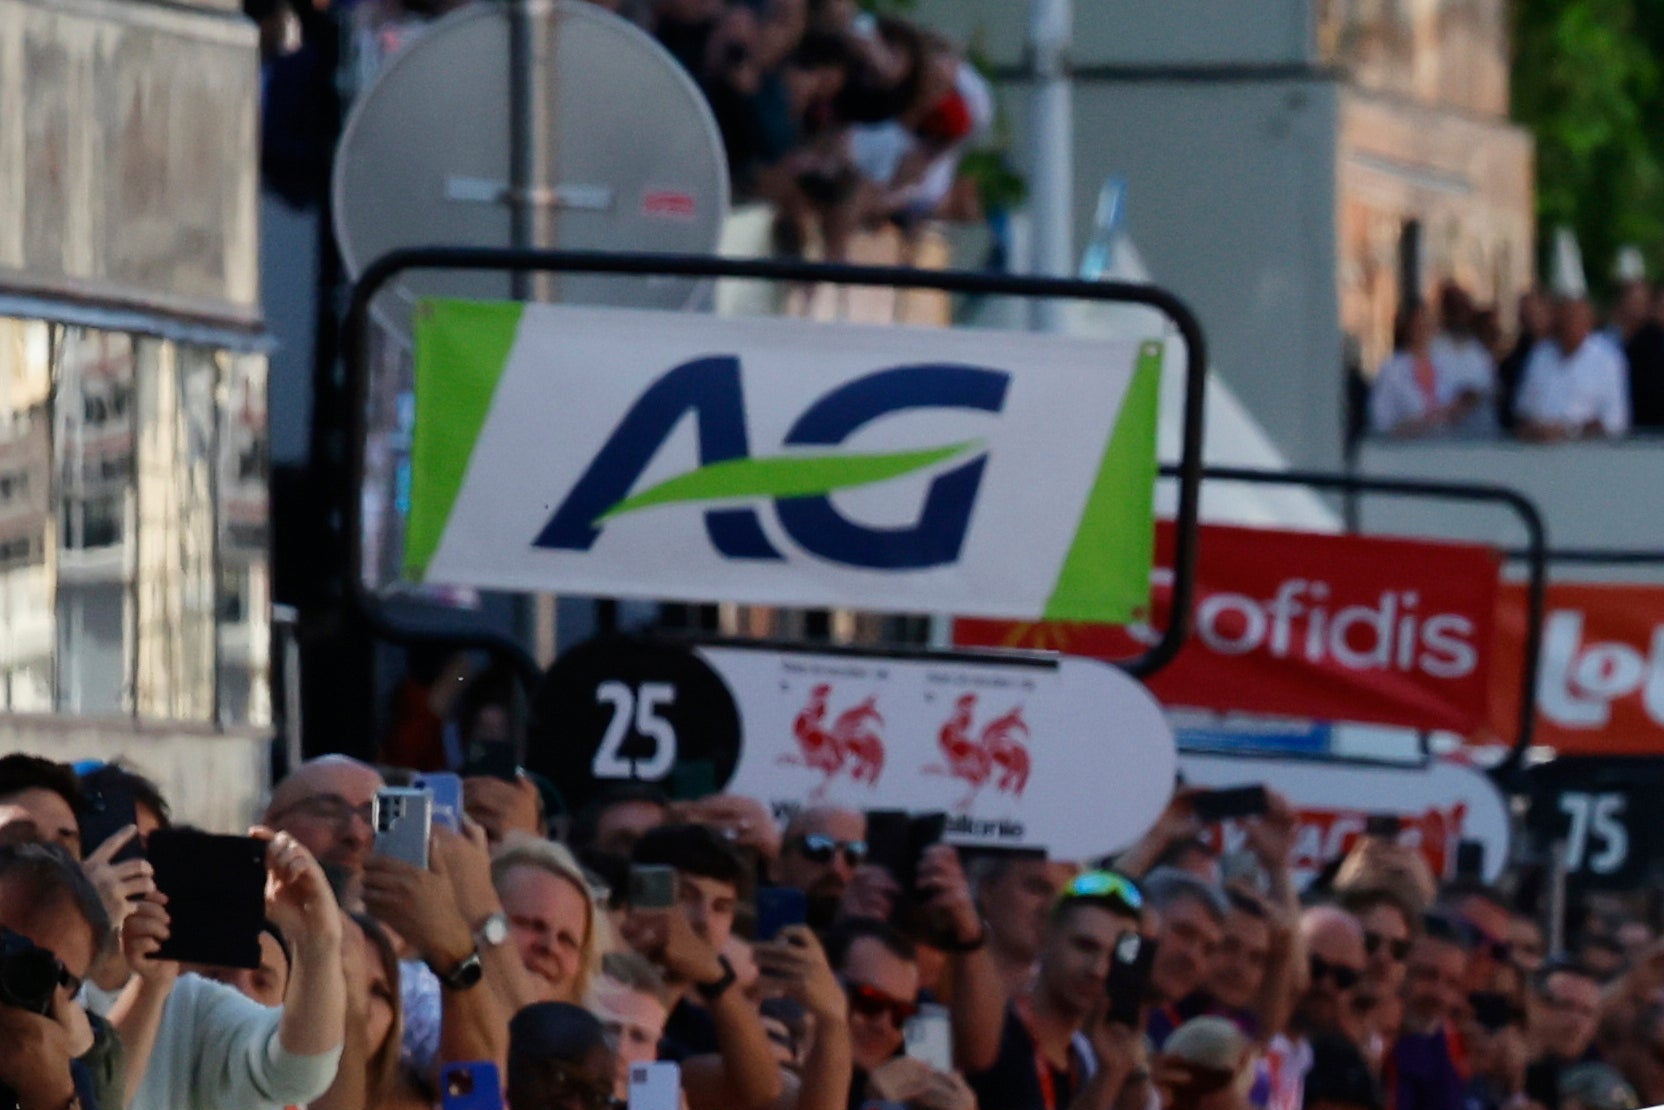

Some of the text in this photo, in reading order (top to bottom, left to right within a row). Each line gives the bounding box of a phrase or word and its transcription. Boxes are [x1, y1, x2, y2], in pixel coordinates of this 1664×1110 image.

[533, 355, 1010, 570] AG
[593, 682, 677, 780] 25
[1561, 790, 1631, 875] 75
